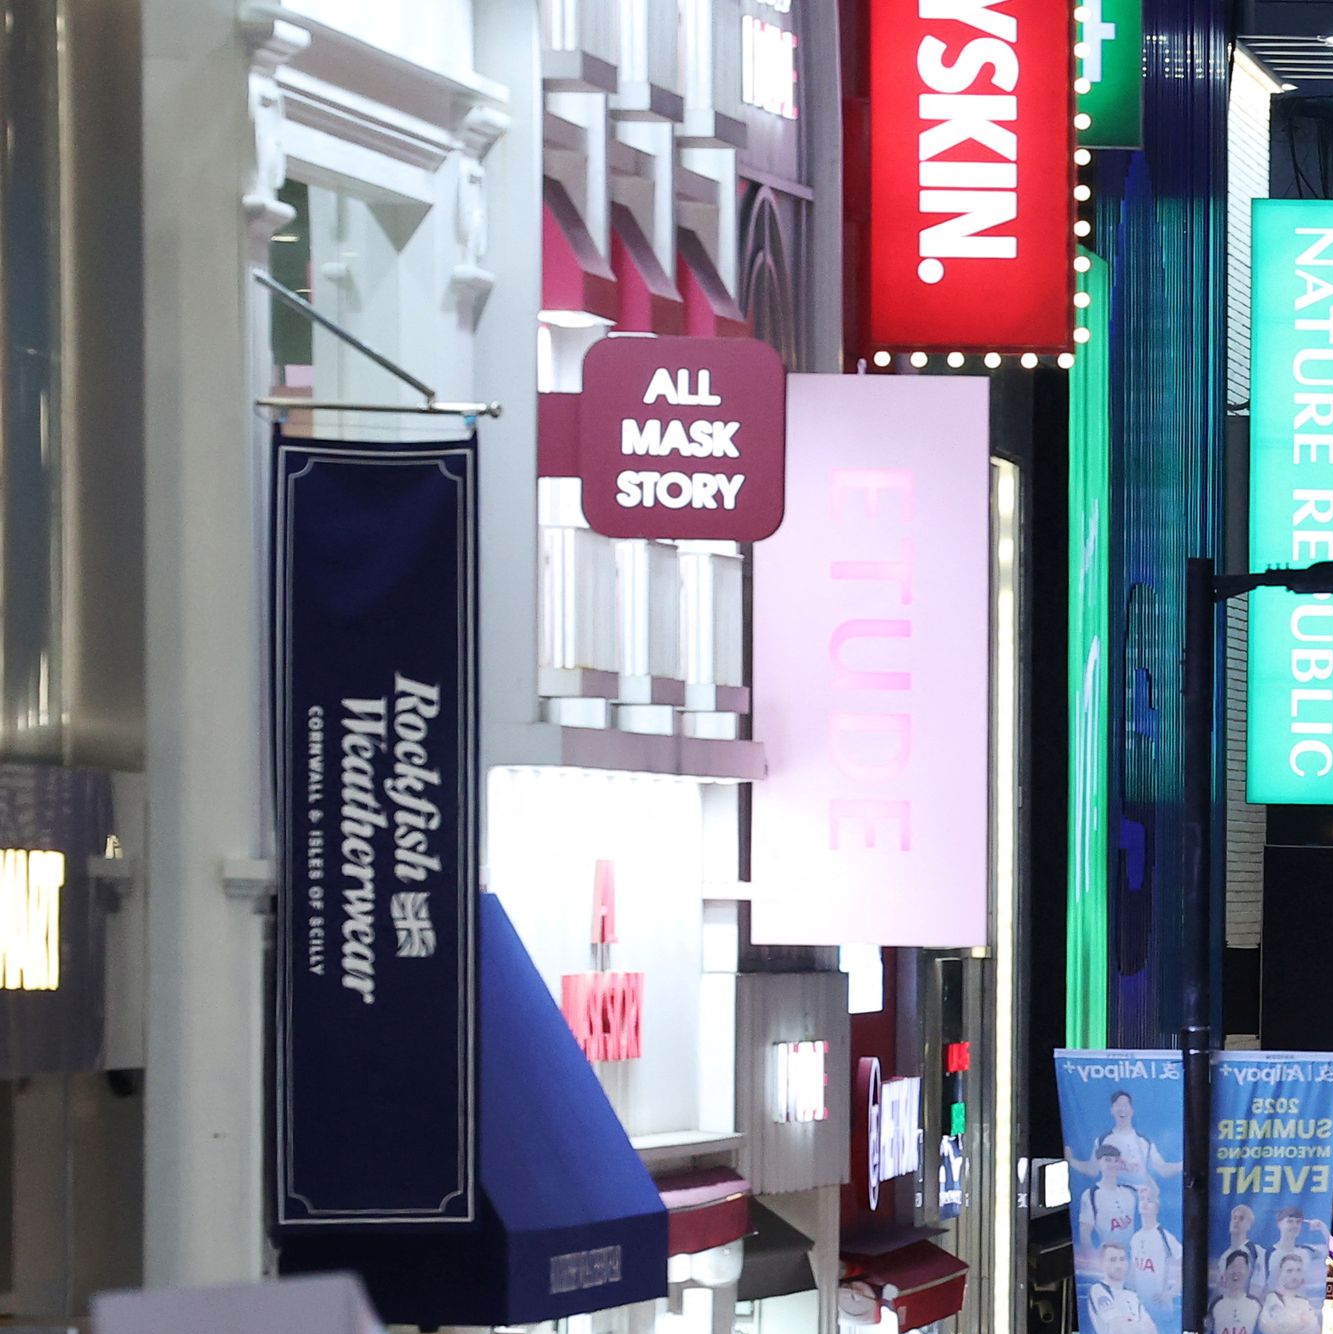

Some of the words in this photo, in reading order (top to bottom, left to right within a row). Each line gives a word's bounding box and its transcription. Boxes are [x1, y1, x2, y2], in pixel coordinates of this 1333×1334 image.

[643, 367, 722, 408] ALL
[621, 418, 741, 459] MASK
[615, 472, 746, 511] STORY
[828, 467, 916, 852] ETUDE
[307, 705, 325, 804] CORNWALL
[384, 670, 443, 884] Rockfish
[307, 829, 325, 881] ISLES
[340, 696, 389, 1005] Weatherwear
